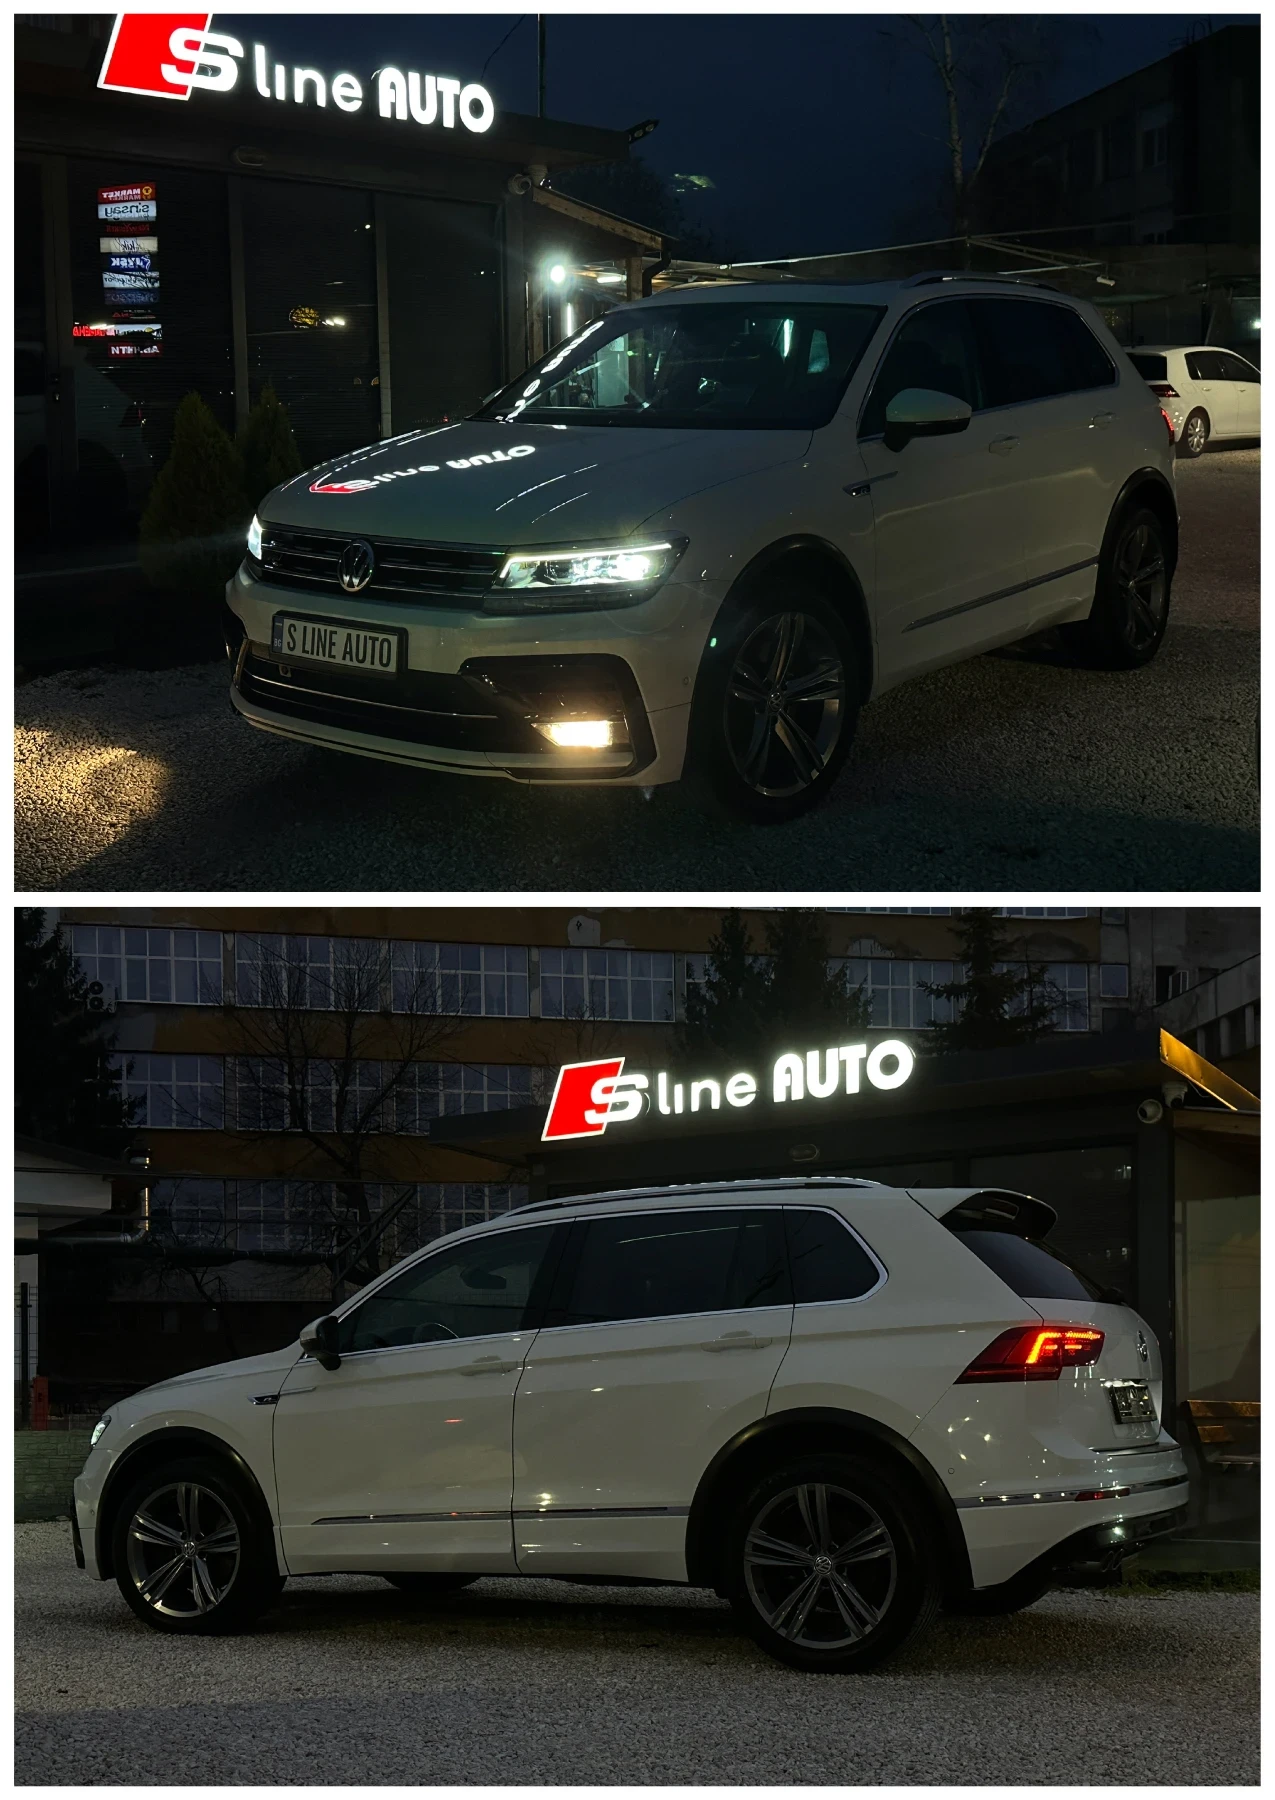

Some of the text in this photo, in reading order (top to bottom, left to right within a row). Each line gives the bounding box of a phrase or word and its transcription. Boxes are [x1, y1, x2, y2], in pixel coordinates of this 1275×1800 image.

[160, 27, 496, 133] S line AUTO
[286, 623, 392, 668] S LINE AUTO
[584, 1039, 914, 1126] S line AUTO
